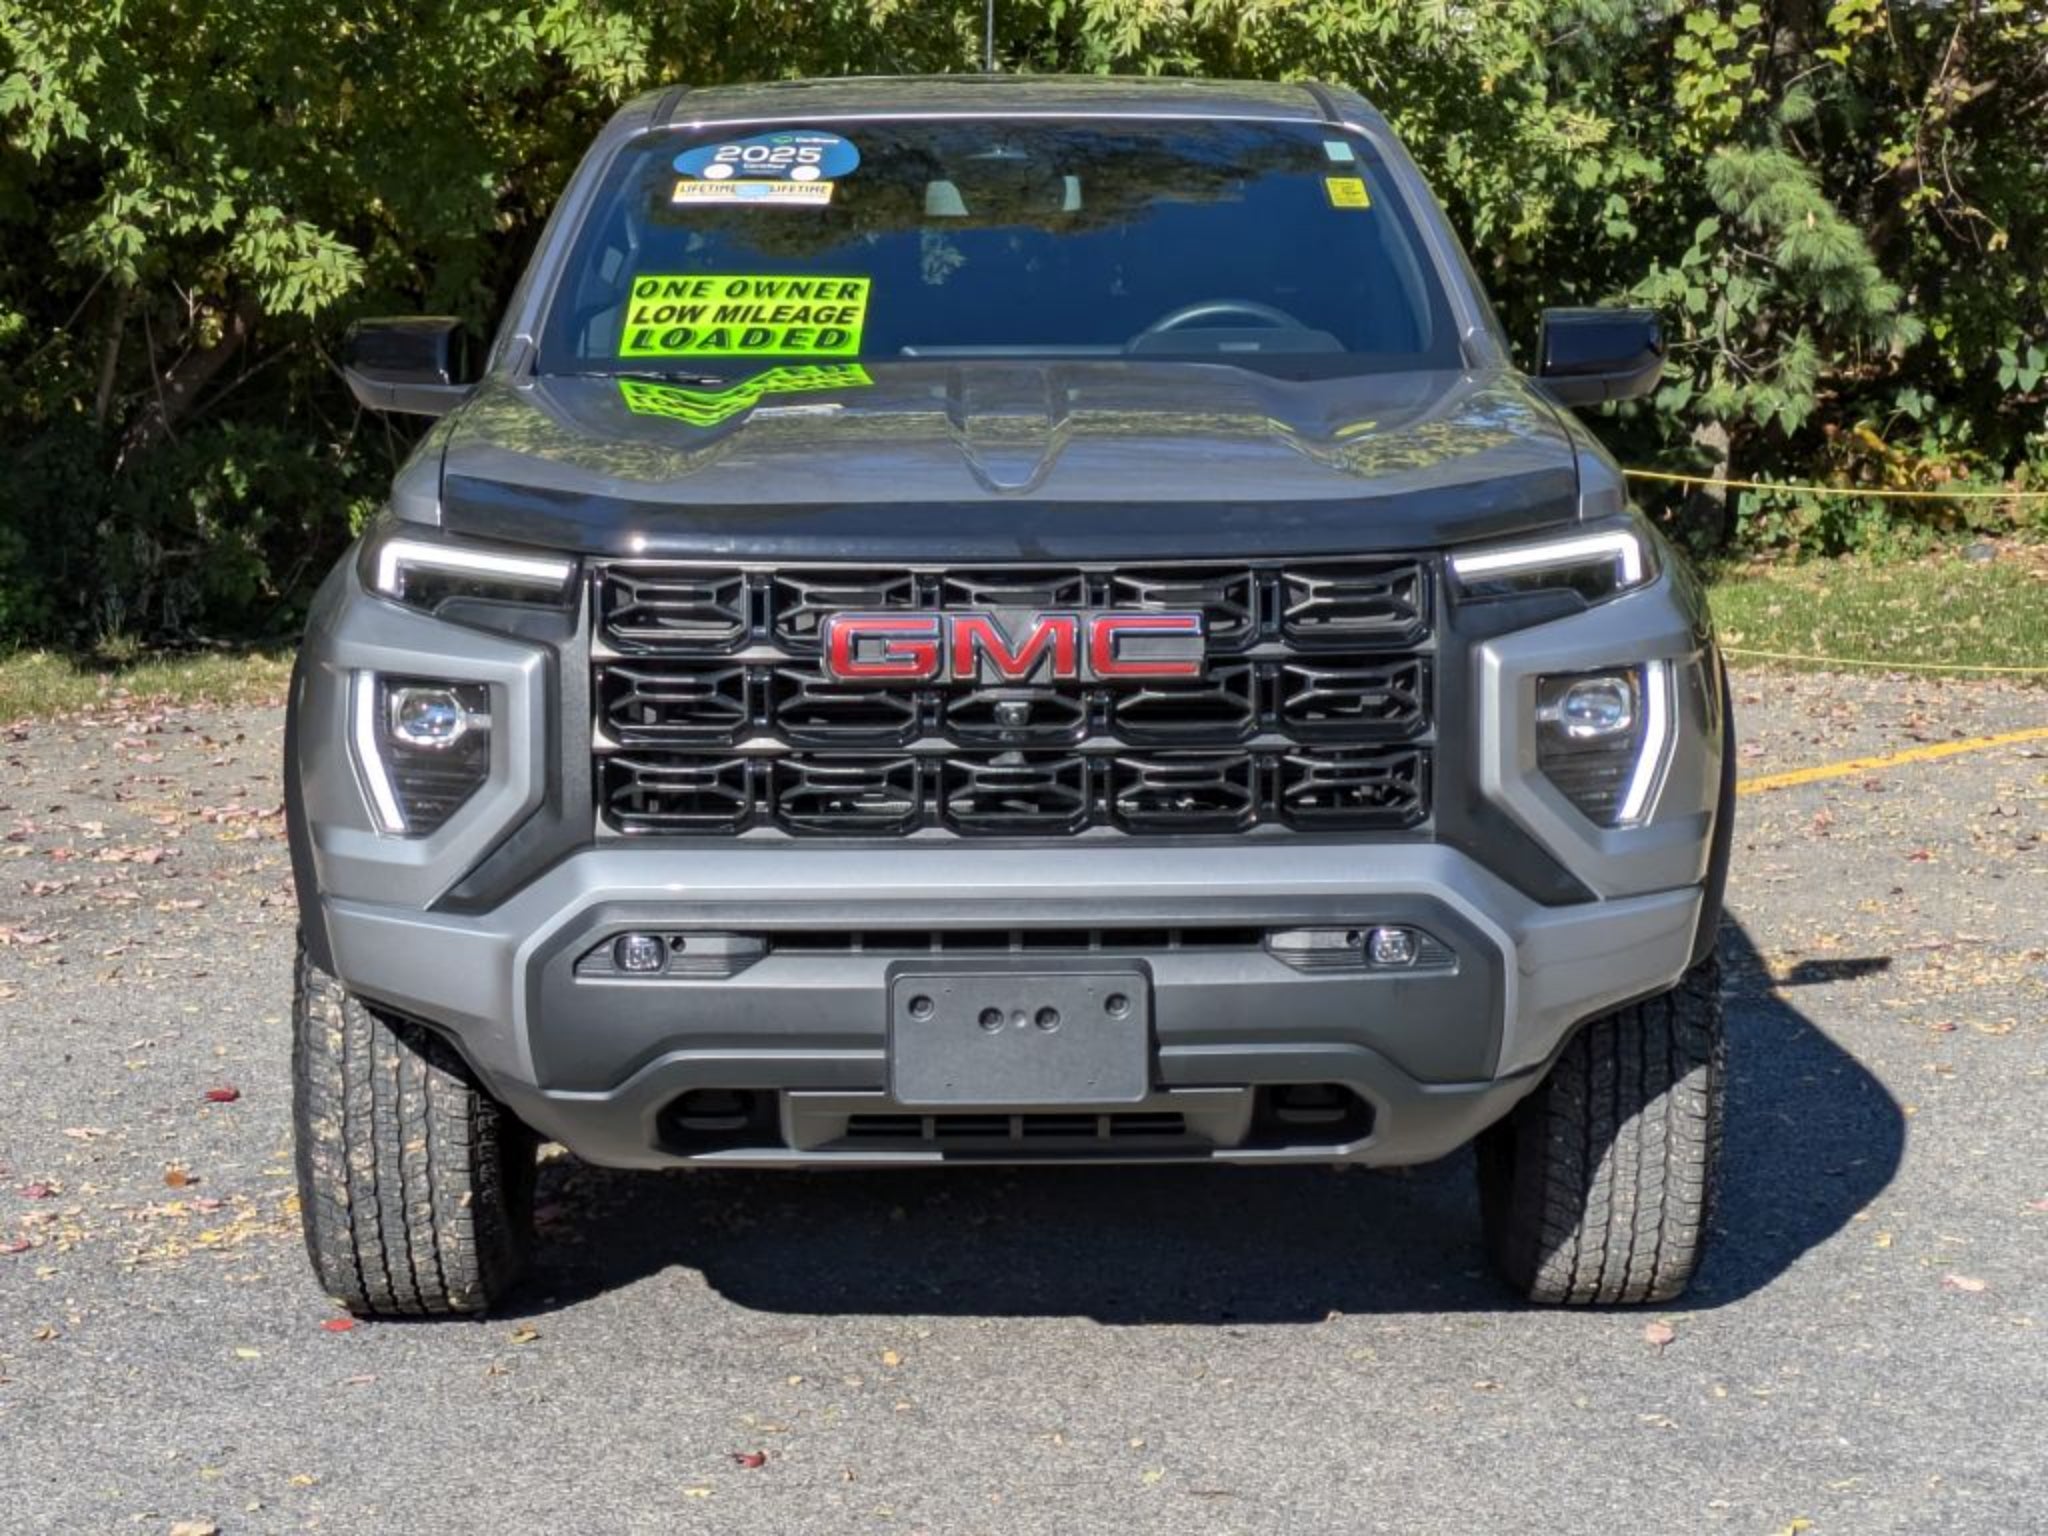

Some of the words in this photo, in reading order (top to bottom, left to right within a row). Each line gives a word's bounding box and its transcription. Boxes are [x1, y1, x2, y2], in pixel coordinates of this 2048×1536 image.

[714, 145, 823, 163] 2025
[680, 183, 736, 193] LIFETIME
[768, 183, 827, 194] LIFETIME
[635, 280, 714, 298] ONE
[725, 280, 862, 299] OWNER
[632, 305, 707, 324] LOW
[711, 305, 860, 324] MILEAGE
[630, 327, 851, 349] LOADED
[822, 611, 1202, 682] GMC
